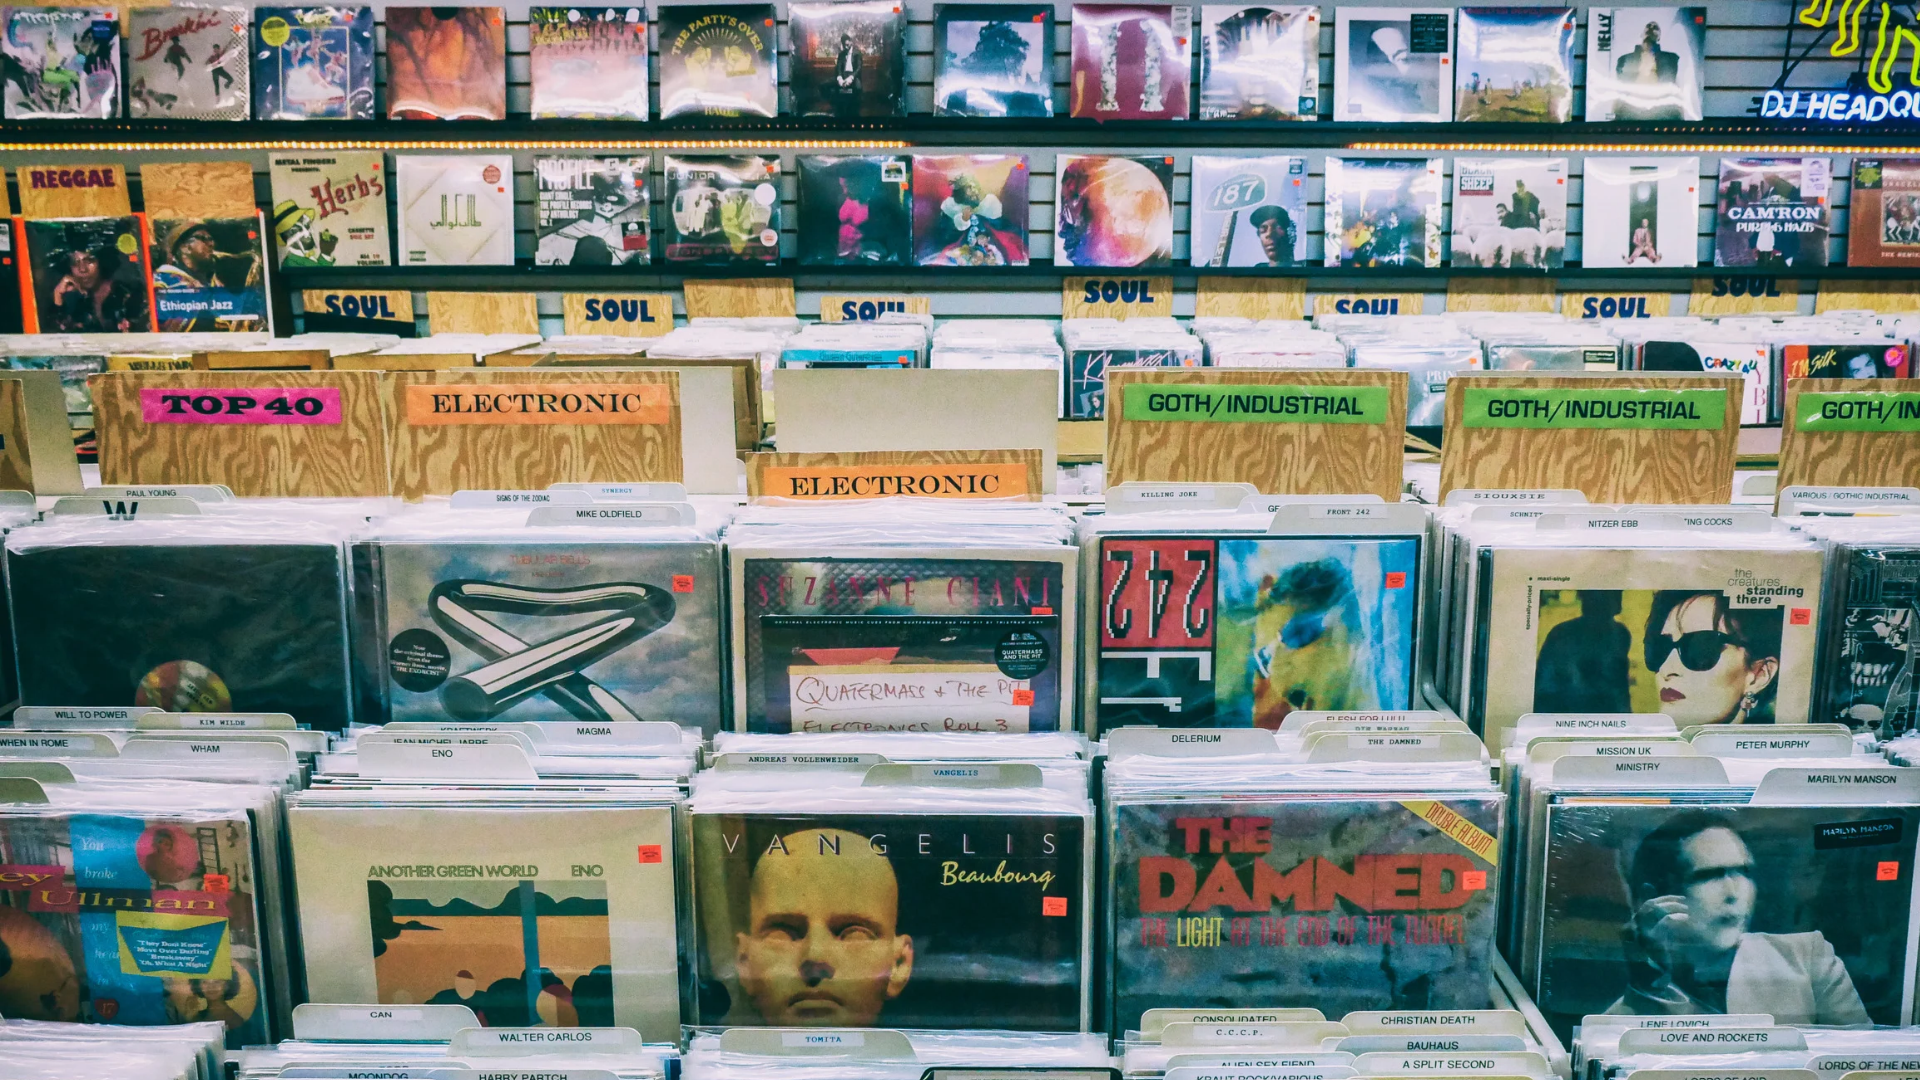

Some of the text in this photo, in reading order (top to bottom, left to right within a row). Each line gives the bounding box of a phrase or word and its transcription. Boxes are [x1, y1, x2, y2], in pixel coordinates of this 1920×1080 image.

[671, 14, 764, 56] THE PARTY'S OVER
[1598, 14, 1611, 51] NELLY
[1760, 90, 1799, 118] DJ
[30, 168, 116, 189] REGGAE
[539, 159, 595, 190] PROFILE
[668, 172, 716, 181] JUNIOR
[1461, 177, 1493, 190] SHEEP
[310, 173, 384, 220] Herbs
[1213, 179, 1260, 207] 187
[1727, 206, 1821, 220] CAM'RON
[1084, 280, 1154, 304] SOUL
[1712, 275, 1781, 298] SOUL
[159, 299, 234, 313] Ethiopian Jazz
[324, 294, 396, 319] SOUL
[585, 299, 655, 324] SOUL
[1582, 297, 1651, 319] SOUL
[162, 394, 324, 416] TOP 40
[432, 392, 643, 414] ELECTRONIC
[1148, 392, 1364, 418] GOTH/INDUSTRIAL
[1487, 399, 1701, 424] GOTH/INDUSTRIAL
[789, 473, 999, 496] ELECTRONIC
[126, 488, 177, 498] PAUL YOUNG
[496, 493, 550, 503] SIGNS OF THE ZODIAC
[1792, 492, 1823, 500] VARIOUS
[1833, 492, 1866, 500] GOTHIC
[1868, 492, 1911, 501] INDUSTRIAL
[102, 500, 138, 521] W
[576, 510, 642, 518] MIKE OLDFIELD
[1327, 508, 1351, 516] FRONT
[1588, 520, 1618, 528] NITZER
[1735, 568, 1752, 578] the
[1727, 577, 1780, 587] creatures
[757, 575, 1050, 608] SUZANNE CIANI
[1746, 585, 1804, 598] standing
[1736, 594, 1772, 604] there
[1525, 585, 1533, 630] specially-priced
[796, 676, 926, 706] QUATERMASS
[947, 680, 992, 698] THE
[55, 711, 128, 719] WILL TO POWER
[1556, 720, 1627, 729] NINE INCH NAILS
[576, 727, 612, 736] MAGMA
[0, 740, 69, 748] WHEN IN ROME
[1172, 734, 1222, 743] DELERIUM
[1736, 740, 1811, 749] PETER MURPHY
[190, 745, 221, 753] WHAM
[432, 749, 453, 758] ENO
[1596, 747, 1651, 756] MISSION UK
[792, 756, 860, 764] VOLLENWEIDER
[1615, 763, 1660, 772] MINISTRY
[1807, 774, 1897, 784] MARILYN MANSON
[1424, 802, 1493, 854] DOUBLE ALBUM
[1822, 823, 1895, 836] MARILYN MANSON
[1175, 816, 1276, 855] THE
[82, 837, 104, 852] You
[722, 833, 1055, 855] VANGELIS
[84, 866, 117, 879] broke
[368, 864, 604, 879] ANOTHER GREEN WORLD ENO
[940, 860, 1056, 891] Beaubourg
[1138, 853, 1479, 914] DAMNED
[91, 923, 110, 933] my
[1139, 914, 1466, 948] THE LIGHT AT THE END OF THE TUNNEL
[101, 1002, 115, 1014] 17
[1381, 1016, 1475, 1025] CHRISTIAN DEATH
[498, 1032, 592, 1042] WALTER CARLOS
[1660, 1033, 1768, 1042] LOVE AND ROCKETS
[1407, 1041, 1459, 1050] BAUHAUS
[1402, 1060, 1495, 1069] A SPLIT SECOND
[1818, 1061, 1855, 1070] LORDS
[1859, 1061, 1873, 1070] OF
[1877, 1061, 1899, 1070] THE
[348, 1072, 409, 1080] MOONDOG
